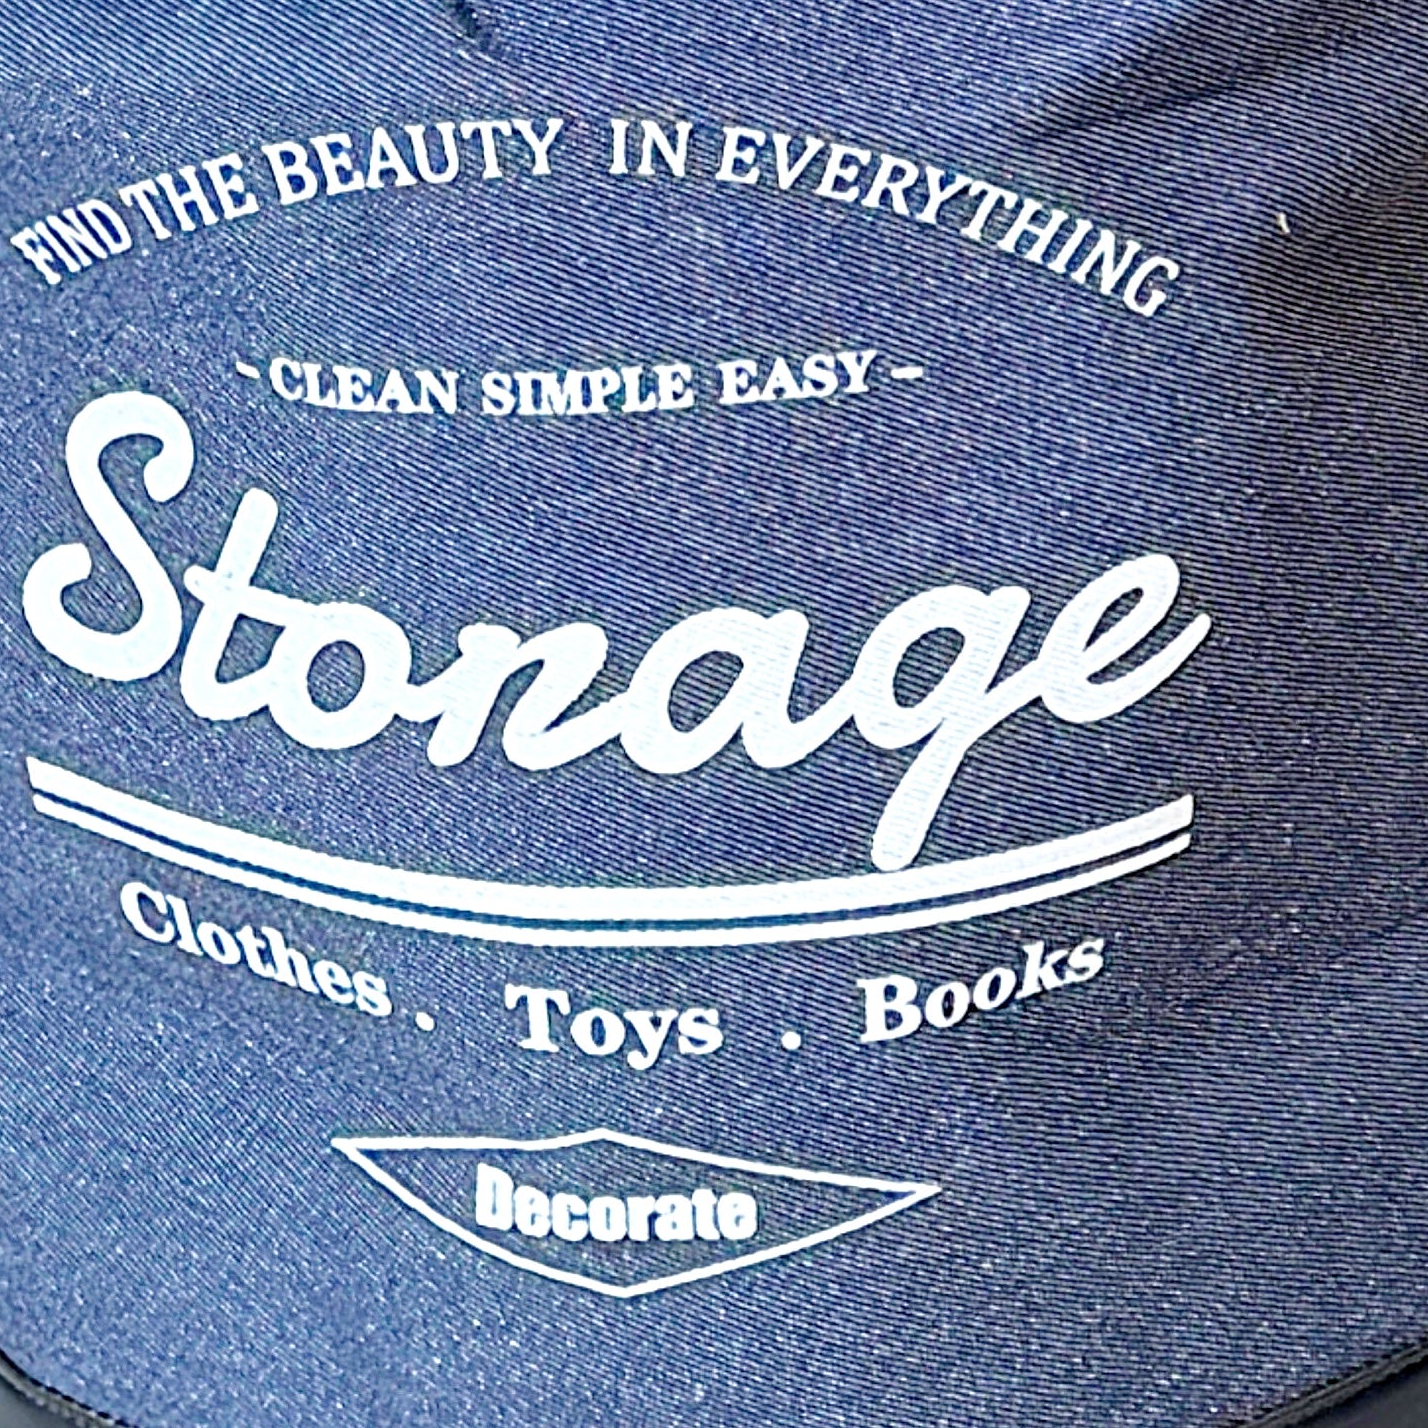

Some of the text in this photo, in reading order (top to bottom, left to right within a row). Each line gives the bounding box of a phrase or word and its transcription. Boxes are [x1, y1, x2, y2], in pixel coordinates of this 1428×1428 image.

[9, 117, 1179, 317] FIND THE BEAUTY IN EVERYTHING
[480, 360, 694, 417] SIMPLE
[21, 389, 1212, 873] Storage
[504, 982, 723, 1071] Toys
[857, 935, 1105, 1043] Books
[474, 1164, 759, 1243] Decorate
